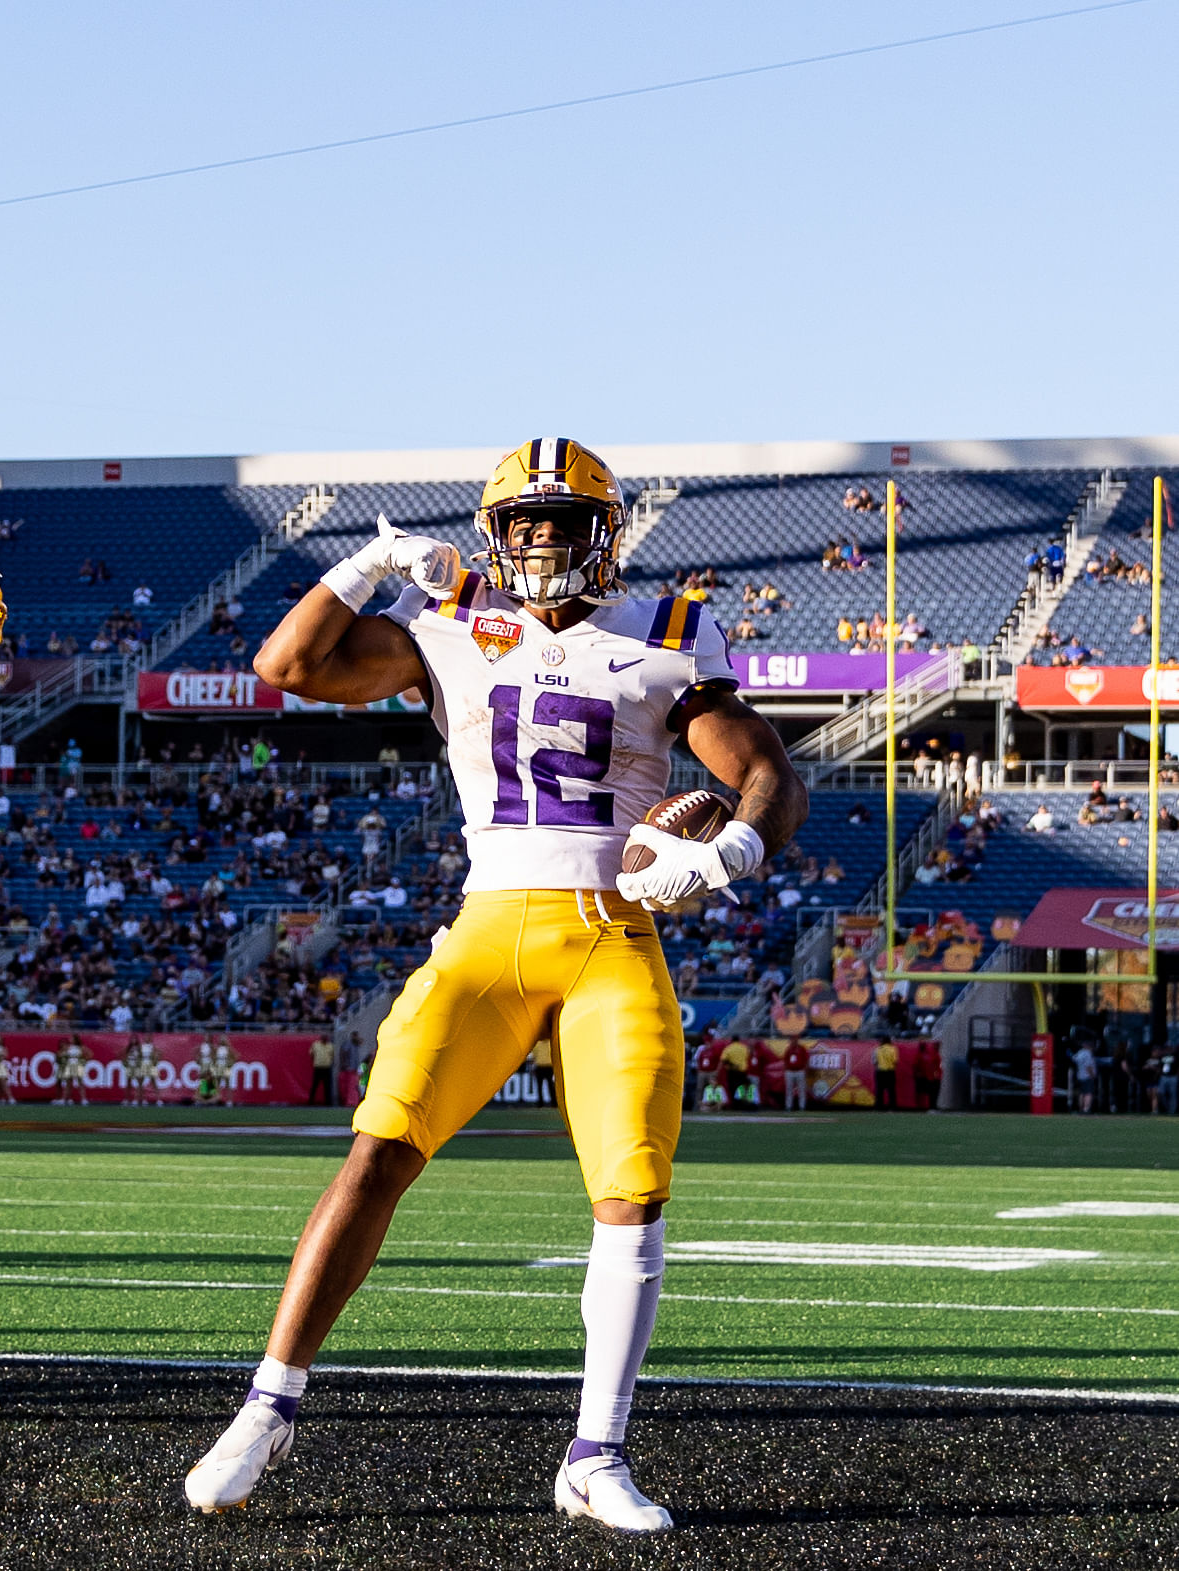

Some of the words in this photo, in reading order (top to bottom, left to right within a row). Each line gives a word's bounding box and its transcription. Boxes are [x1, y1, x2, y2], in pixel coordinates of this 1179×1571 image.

[534, 673, 569, 687] LSU
[748, 655, 808, 687] LSU
[489, 684, 615, 827] 12
